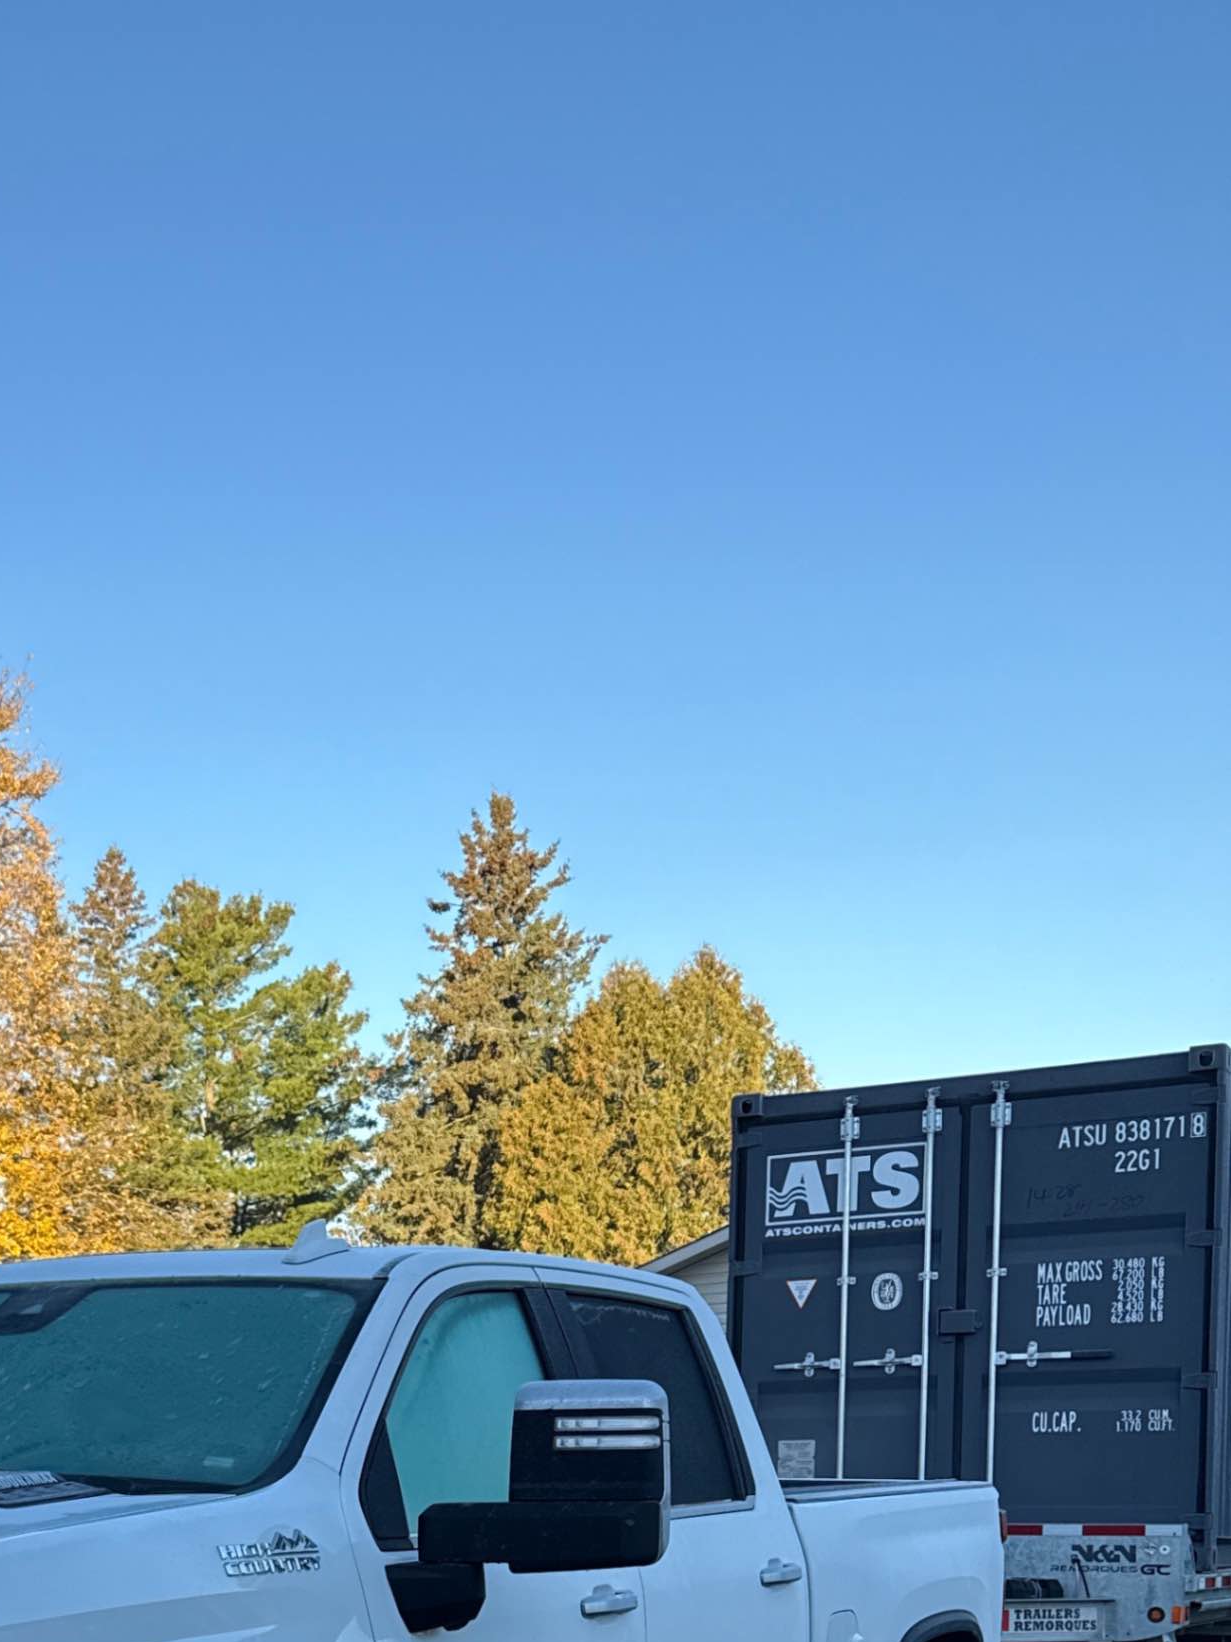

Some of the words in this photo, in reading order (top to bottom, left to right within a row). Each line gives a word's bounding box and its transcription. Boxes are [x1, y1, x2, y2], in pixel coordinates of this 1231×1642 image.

[1058, 1123, 1107, 1149] ATSU
[1115, 1115, 1185, 1143] 838171
[1114, 1148, 1160, 1173] 22G1
[771, 1151, 920, 1218] ATS
[765, 1217, 926, 1238] ATSCONTANERS.COM
[1037, 1262, 1063, 1284] MAX
[1065, 1260, 1103, 1282] GROSS
[1151, 1256, 1165, 1268] KG
[1037, 1283, 1067, 1305] TARE
[1151, 1278, 1164, 1289] KG
[1036, 1304, 1091, 1327] PAYLOAD
[1150, 1300, 1164, 1312] KG
[1032, 1411, 1082, 1433] CU.CAP.
[217, 1542, 272, 1560] HIGH
[1072, 1544, 1137, 1564] N&N
[223, 1556, 321, 1577] COUNTRY
[1140, 1564, 1171, 1576] GC
[1014, 1607, 1081, 1620] TRAILERS
[1014, 1619, 1097, 1632] REMORQUES
